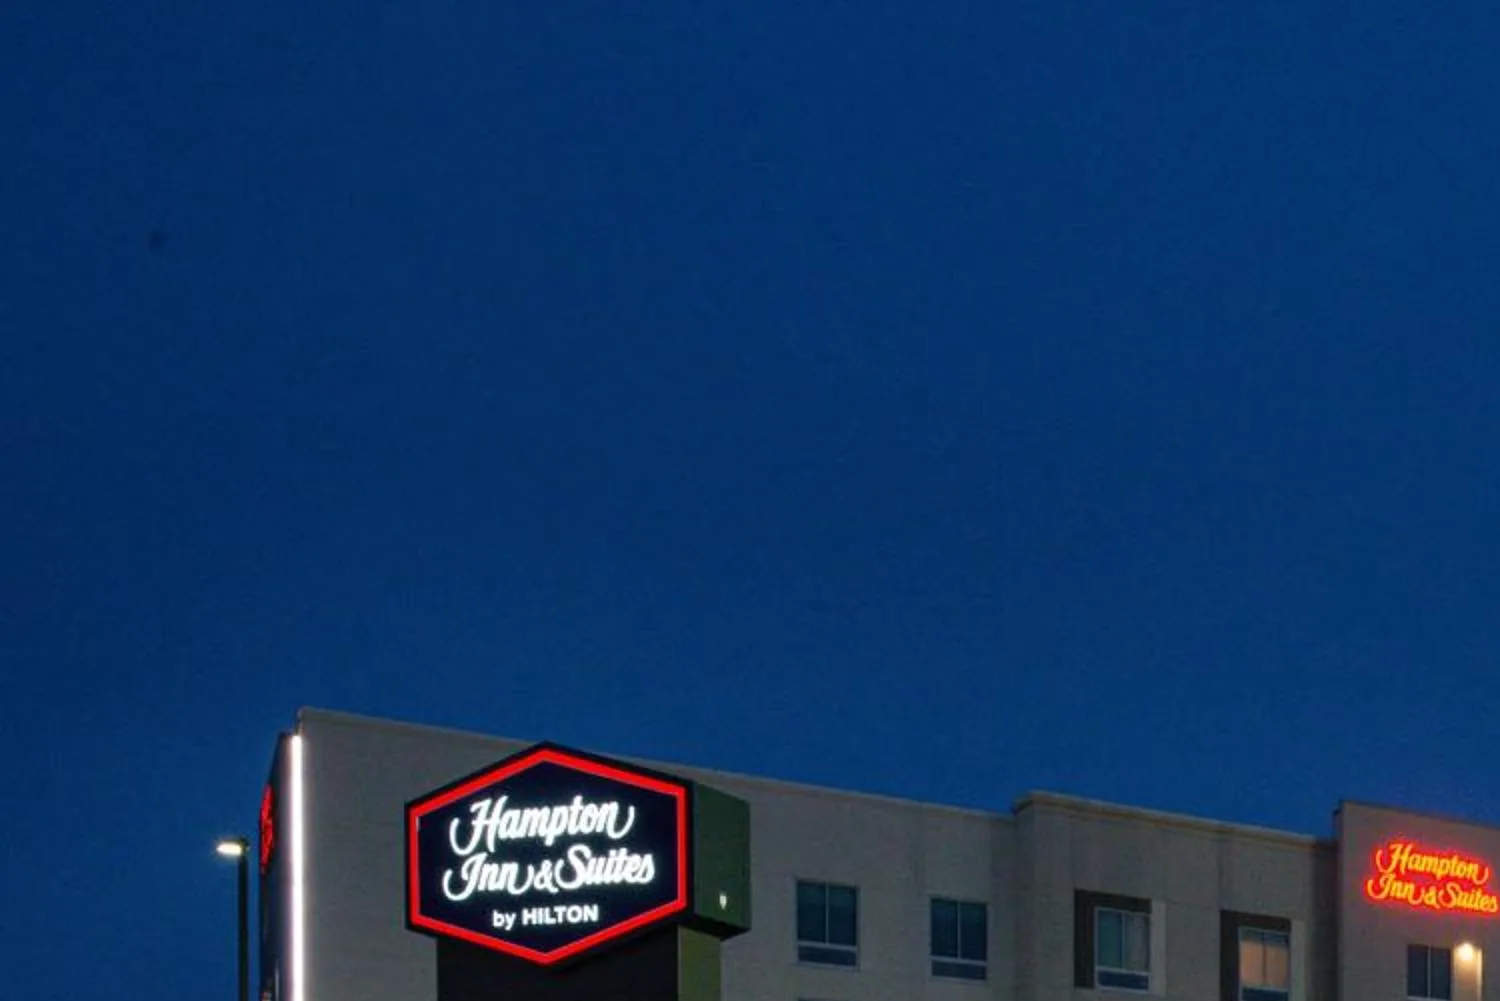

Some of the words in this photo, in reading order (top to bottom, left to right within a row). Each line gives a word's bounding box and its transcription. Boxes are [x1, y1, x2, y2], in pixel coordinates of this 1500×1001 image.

[450, 795, 635, 856] Hampton
[442, 851, 532, 901] Inn
[533, 860, 558, 894] &
[555, 845, 656, 890] Suites
[1375, 843, 1489, 885] Hampton
[1367, 873, 1424, 905] Inn
[1438, 882, 1499, 913] Suites
[492, 910, 515, 931] by
[522, 904, 599, 926] HILTON
